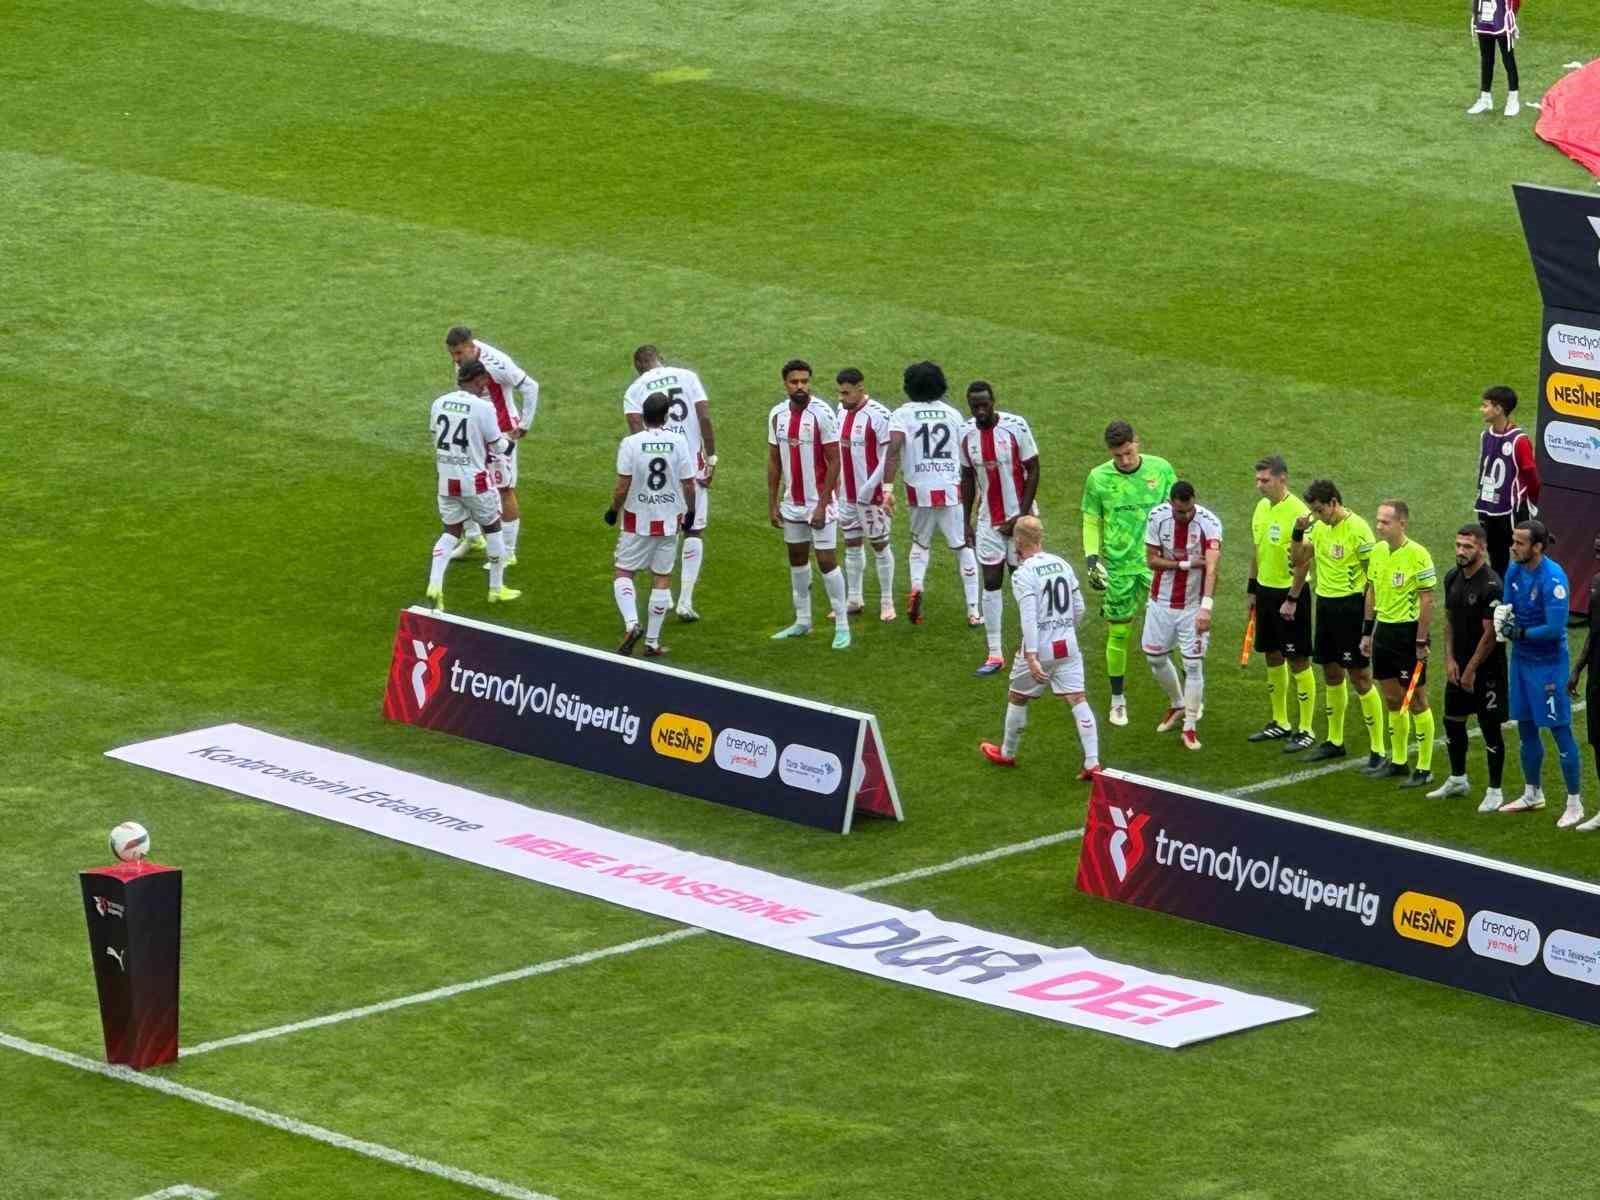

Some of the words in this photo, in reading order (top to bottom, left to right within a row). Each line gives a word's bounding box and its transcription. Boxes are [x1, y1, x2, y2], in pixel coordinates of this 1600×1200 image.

[437, 414, 469, 453] 24
[914, 423, 952, 459] 12
[648, 457, 667, 491] 8
[1041, 576, 1070, 616] 10
[450, 659, 556, 716] trendyol
[1486, 690, 1498, 709] 2
[1546, 695, 1556, 714] 1
[726, 734, 768, 757] trendyol
[495, 832, 619, 869] MEME
[1155, 828, 1280, 892] trendyol
[1481, 918, 1531, 942] trendyol
[808, 917, 1043, 984] DUR
[1007, 970, 1225, 1025] DE!
